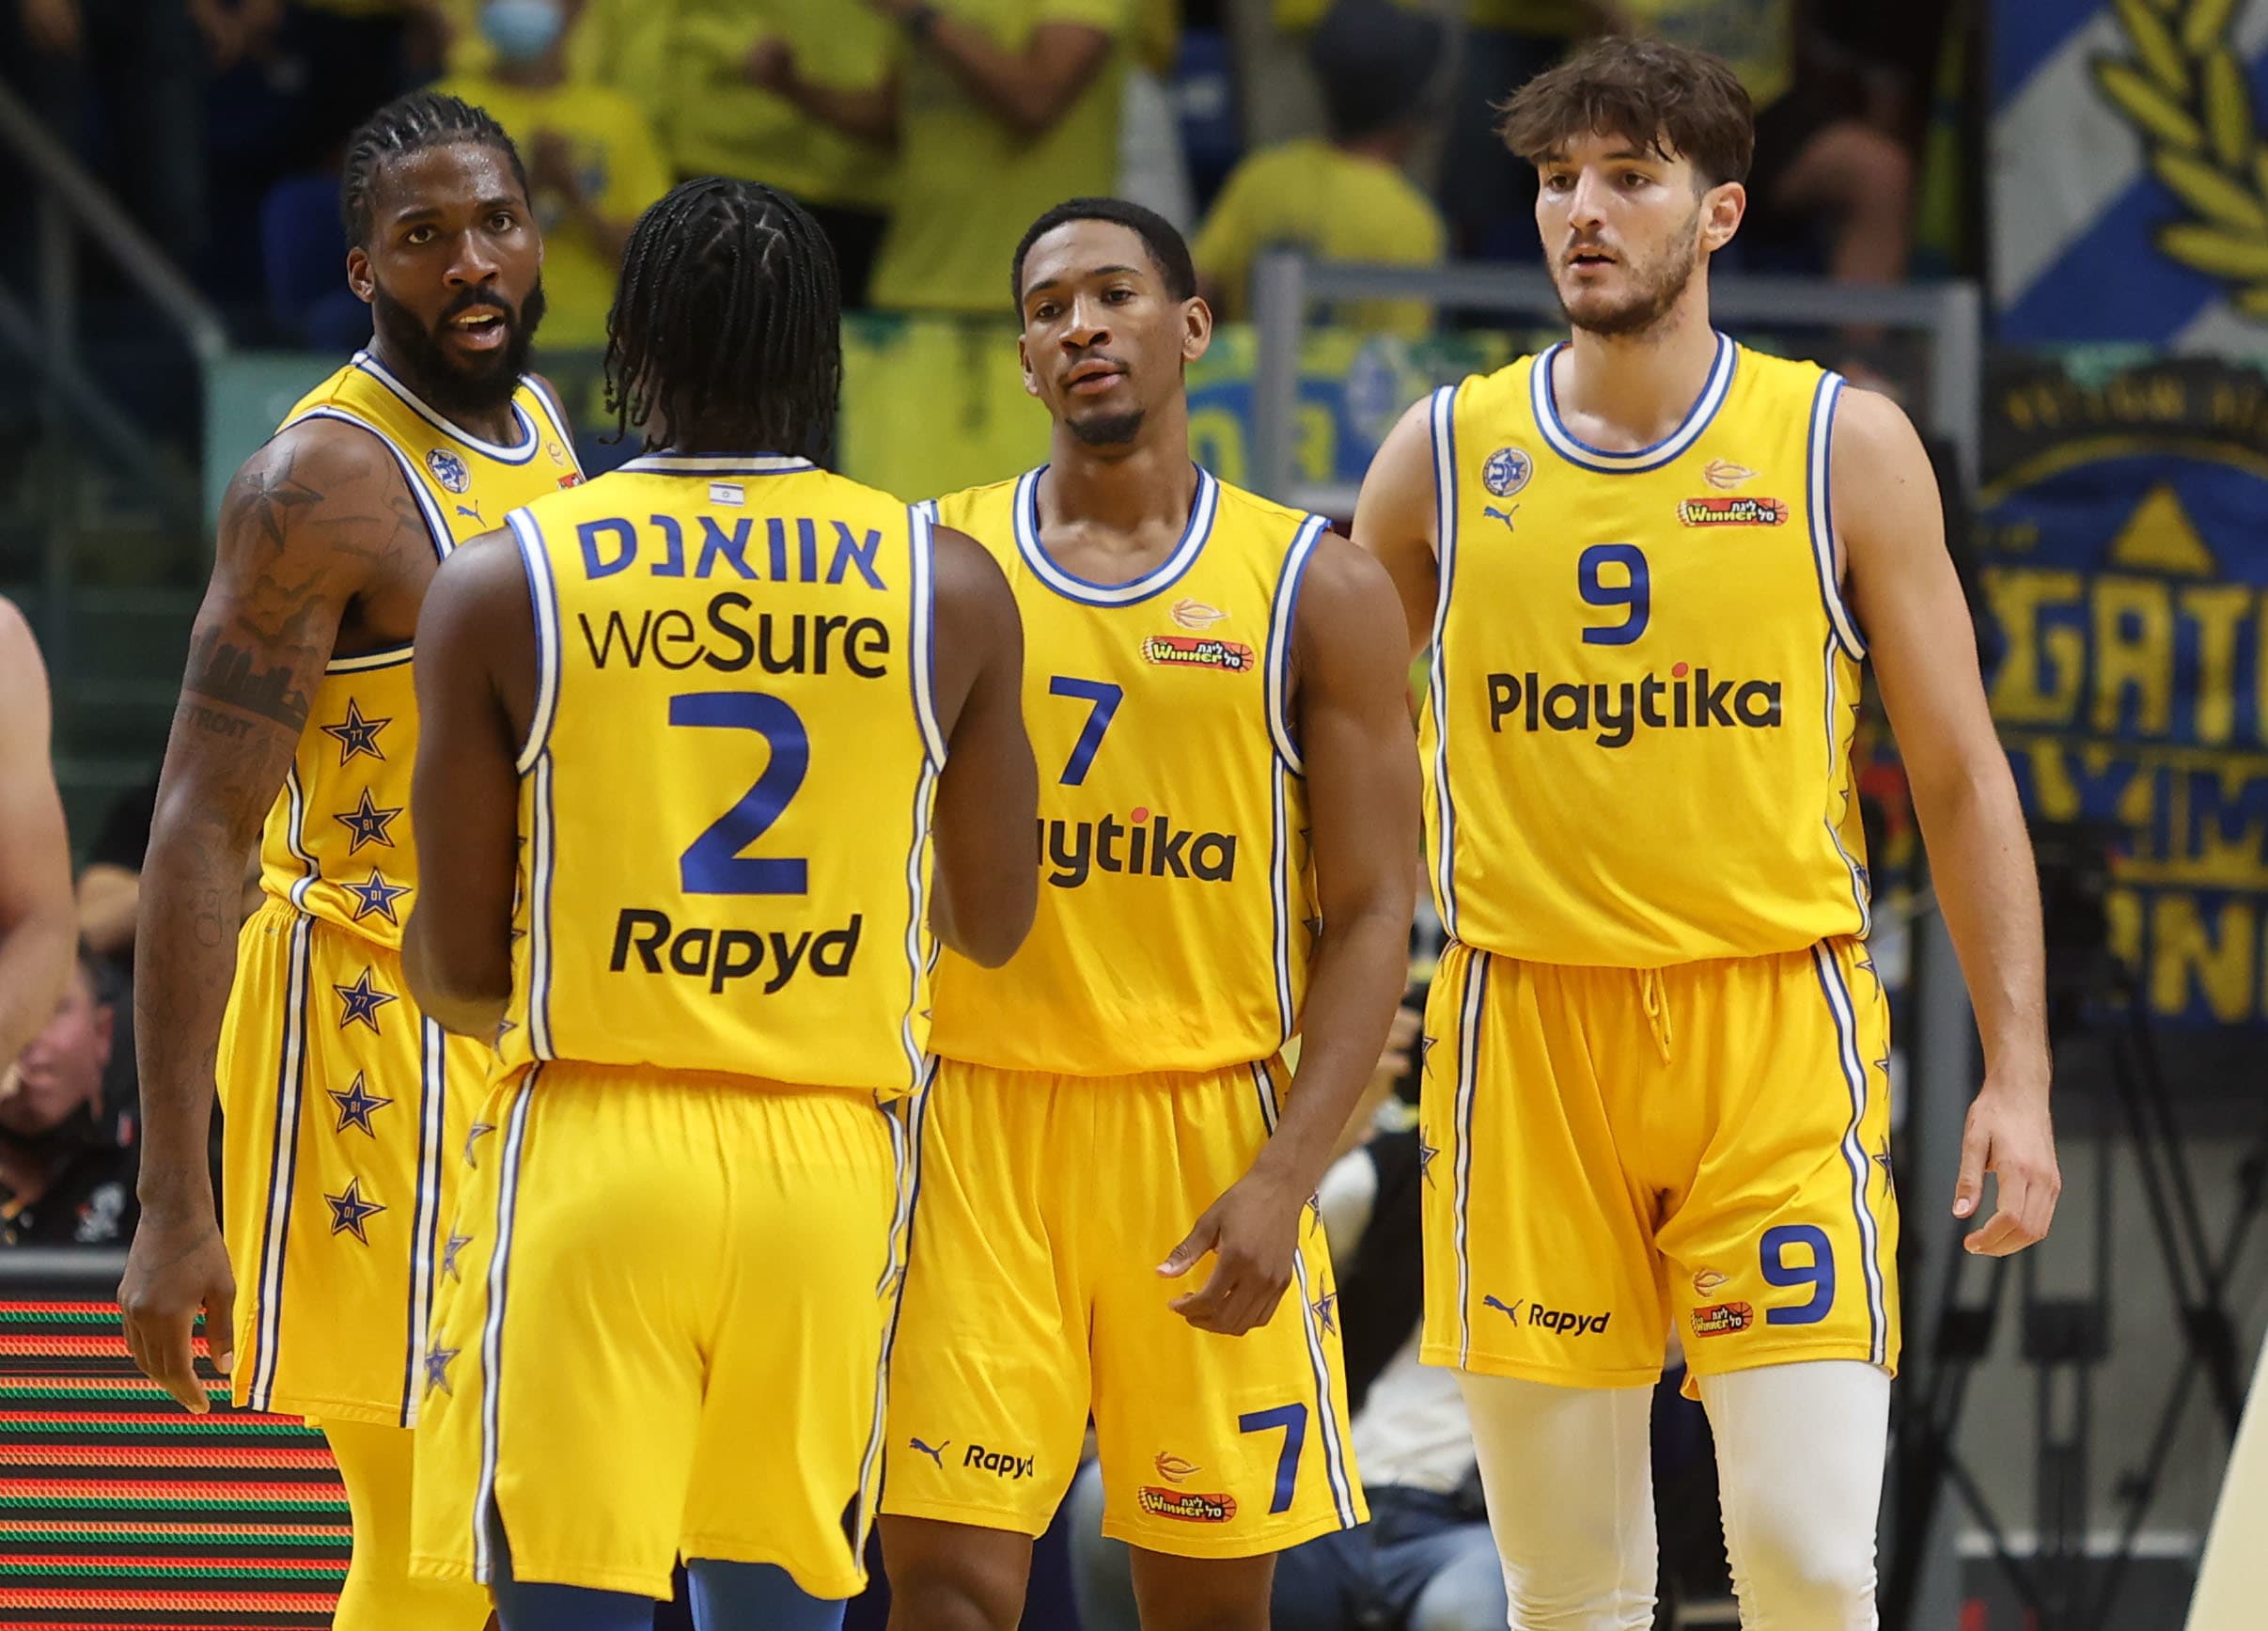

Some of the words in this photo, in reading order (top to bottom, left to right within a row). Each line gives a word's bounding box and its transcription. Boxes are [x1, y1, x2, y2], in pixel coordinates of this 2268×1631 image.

[576, 514, 888, 590] אוואנס
[1687, 505, 1756, 522] Winner
[1578, 543, 1650, 645] 9
[578, 591, 889, 679] weSure
[1152, 643, 1222, 664] Winner
[350, 729, 363, 742] 77
[1049, 675, 1124, 786] 7
[1487, 662, 1782, 748] Playtika
[668, 691, 809, 895] 2
[1038, 807, 1237, 888] ytika
[609, 908, 863, 995] Rapyd
[354, 995, 368, 1009] 77
[1760, 1224, 1836, 1325] 9
[1528, 1303, 1611, 1337] Rapyd
[963, 1444, 1034, 1480] Rapyd
[1239, 1402, 1308, 1513] 7
[1146, 1494, 1204, 1517] Winner
